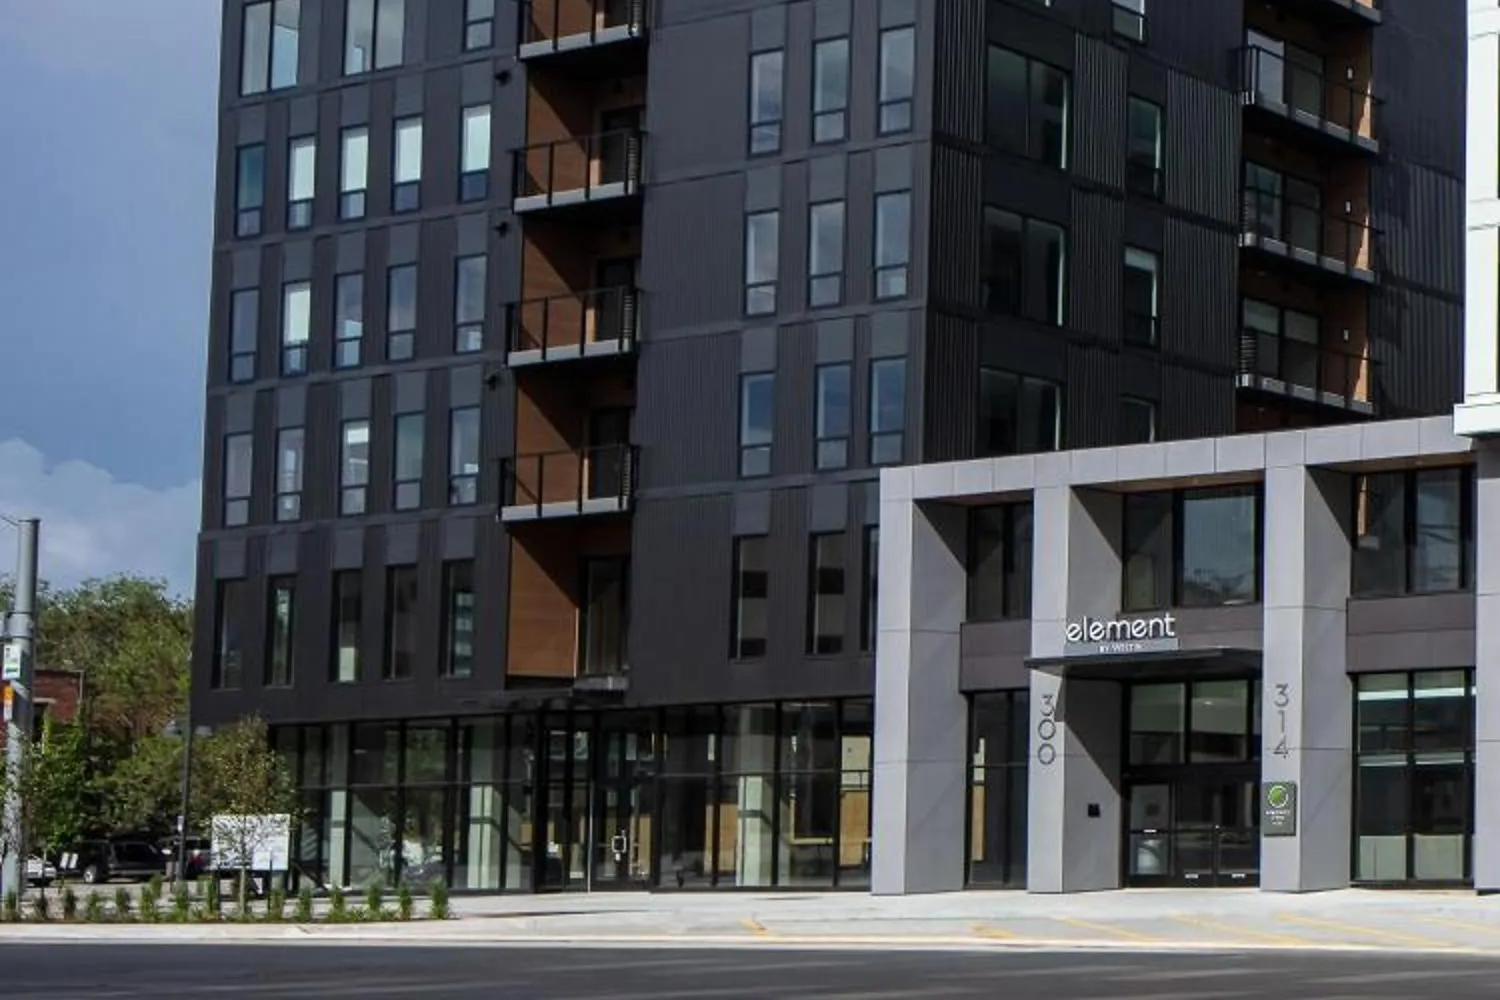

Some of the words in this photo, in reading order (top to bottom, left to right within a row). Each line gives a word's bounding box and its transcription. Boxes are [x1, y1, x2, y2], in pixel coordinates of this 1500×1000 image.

[1065, 612, 1176, 642] element
[1037, 694, 1057, 766] 300
[1273, 683, 1290, 760] 314
